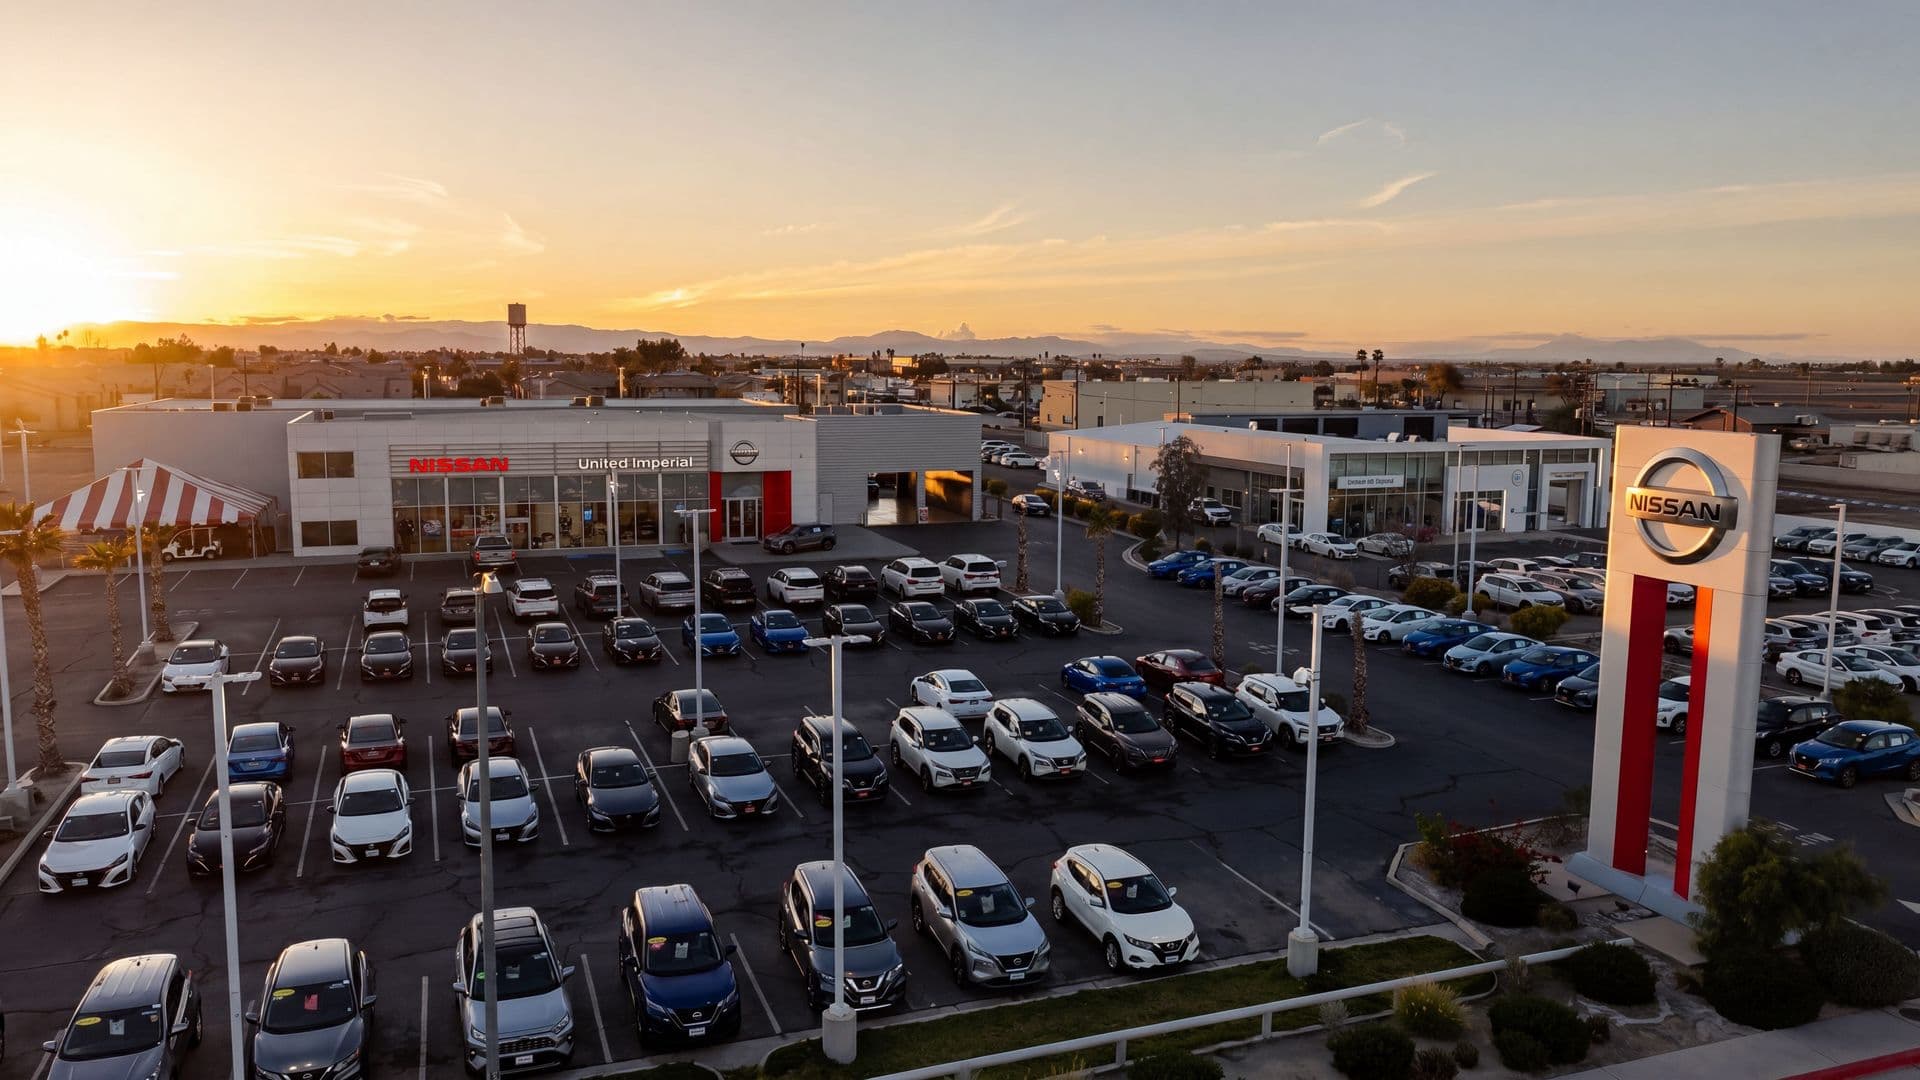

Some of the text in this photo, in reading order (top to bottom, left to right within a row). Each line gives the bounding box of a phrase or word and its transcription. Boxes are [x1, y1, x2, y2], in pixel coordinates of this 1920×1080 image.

[409, 457, 509, 473] NISSAN
[578, 457, 693, 470] United Imperial
[1629, 493, 1721, 521] NISSAN
